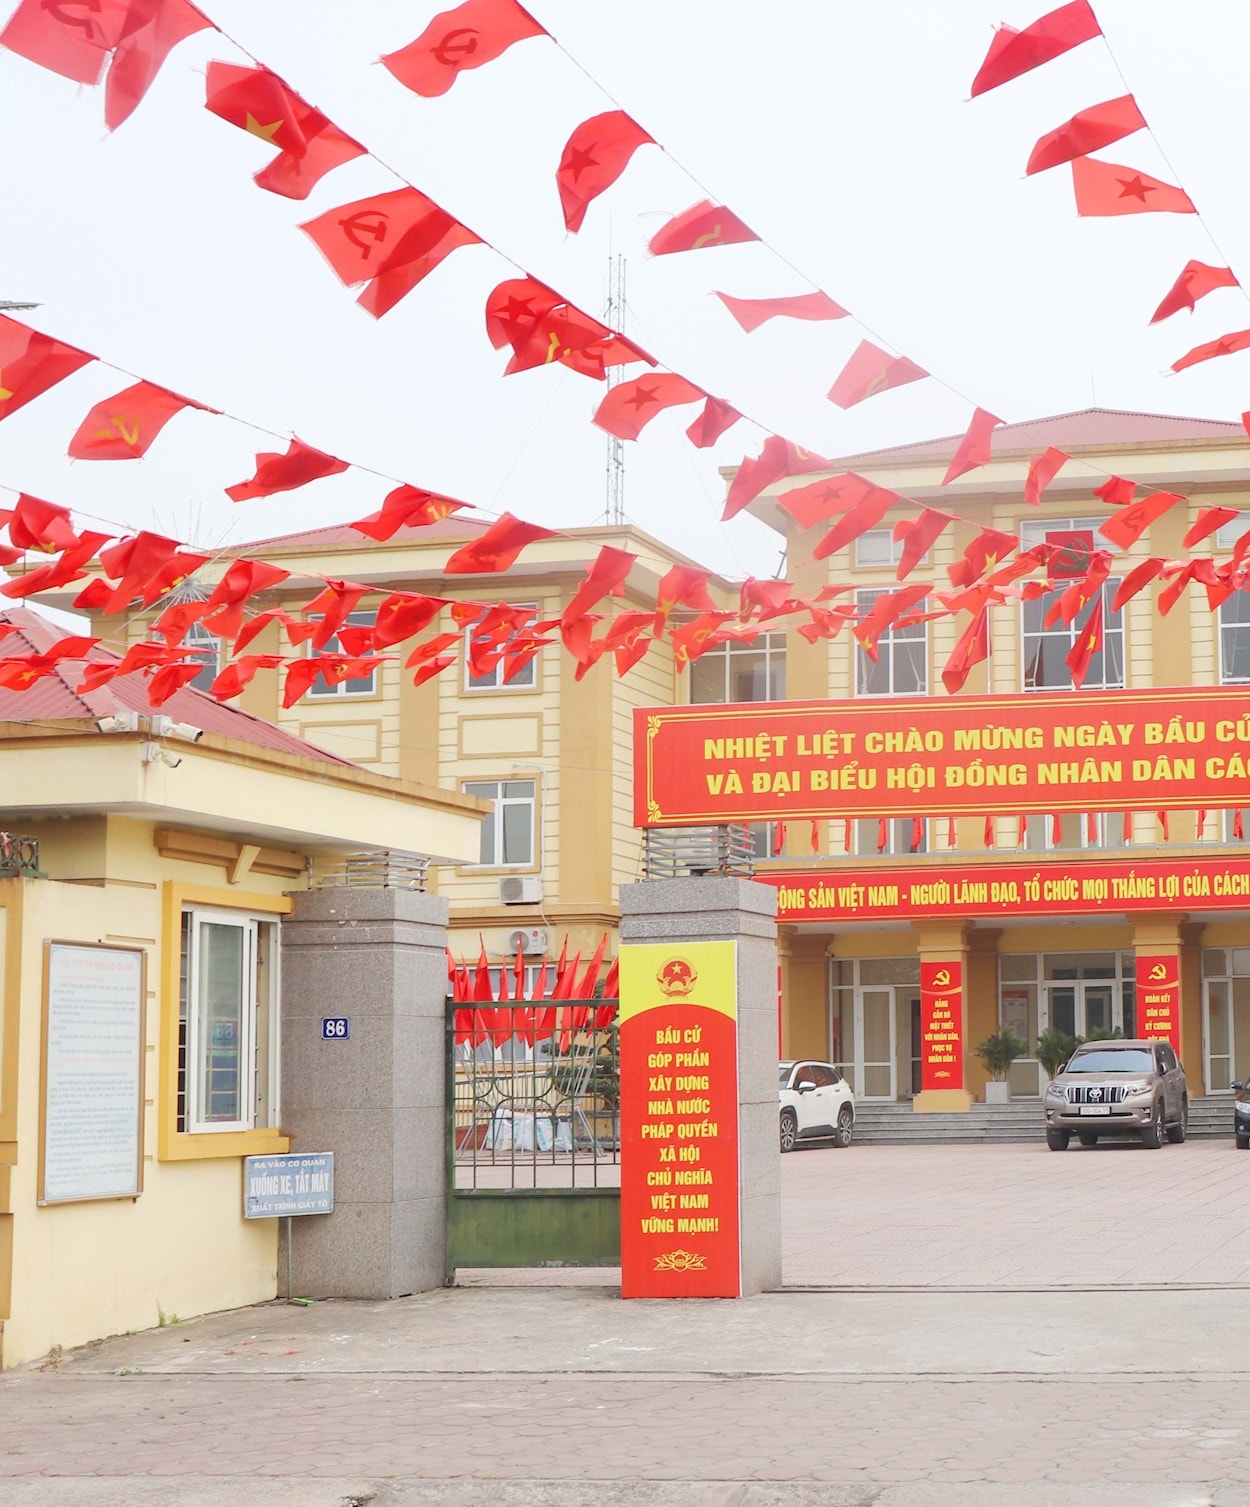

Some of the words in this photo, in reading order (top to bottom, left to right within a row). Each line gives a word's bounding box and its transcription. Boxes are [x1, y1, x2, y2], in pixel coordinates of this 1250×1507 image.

[705, 733, 787, 761] NHIỆT
[798, 730, 855, 762] LIỆT
[866, 727, 943, 753] CHÀO
[955, 725, 1043, 750] MỪNG
[1054, 721, 1134, 747] NGÀY
[1145, 715, 1205, 744] BẦU
[707, 770, 743, 794] VÀ
[752, 771, 800, 796] ĐẠI
[811, 757, 876, 790] BIỂU
[887, 763, 935, 792] HỘI
[945, 759, 1027, 787] ĐỒNG
[1038, 758, 1121, 784] NHÂN
[1133, 755, 1195, 781] DÂN
[809, 882, 834, 908] SẢN
[838, 883, 865, 911] VIỆT
[869, 886, 898, 906] NAM
[911, 879, 950, 905] NGƯỜI
[954, 880, 987, 903] LÃNH
[991, 882, 1020, 906] ĐẠO,
[1024, 873, 1040, 901] TỔ
[1044, 876, 1078, 900] CHỨC
[1083, 879, 1108, 904] MỌI
[1112, 871, 1155, 898] THẮNG
[1159, 875, 1179, 901] LỢI
[1184, 869, 1210, 896] CỦA
[1214, 871, 1249, 895] CÁCH
[326, 1020, 345, 1036] 86
[657, 1026, 680, 1044] BẦU
[684, 1025, 701, 1043] CỬ
[648, 1051, 672, 1067] GÓP
[676, 1048, 709, 1067] PHẦN
[649, 1075, 672, 1091] XÂY
[676, 1076, 709, 1093] DỰNG
[649, 1098, 673, 1114] NHÀ
[677, 1097, 710, 1114] NƯỚC
[642, 1122, 674, 1138] PHÁP
[678, 1119, 717, 1139] QUYỀN
[660, 1145, 676, 1161] XÃ
[680, 1145, 699, 1164] HỘI
[648, 1167, 671, 1185] CHỦ
[675, 1168, 712, 1185] NGHĨA
[651, 1193, 676, 1212] VIỆT
[680, 1195, 708, 1208] NAM
[642, 1217, 674, 1233] VỮNG
[678, 1218, 718, 1235] MẠNH!
